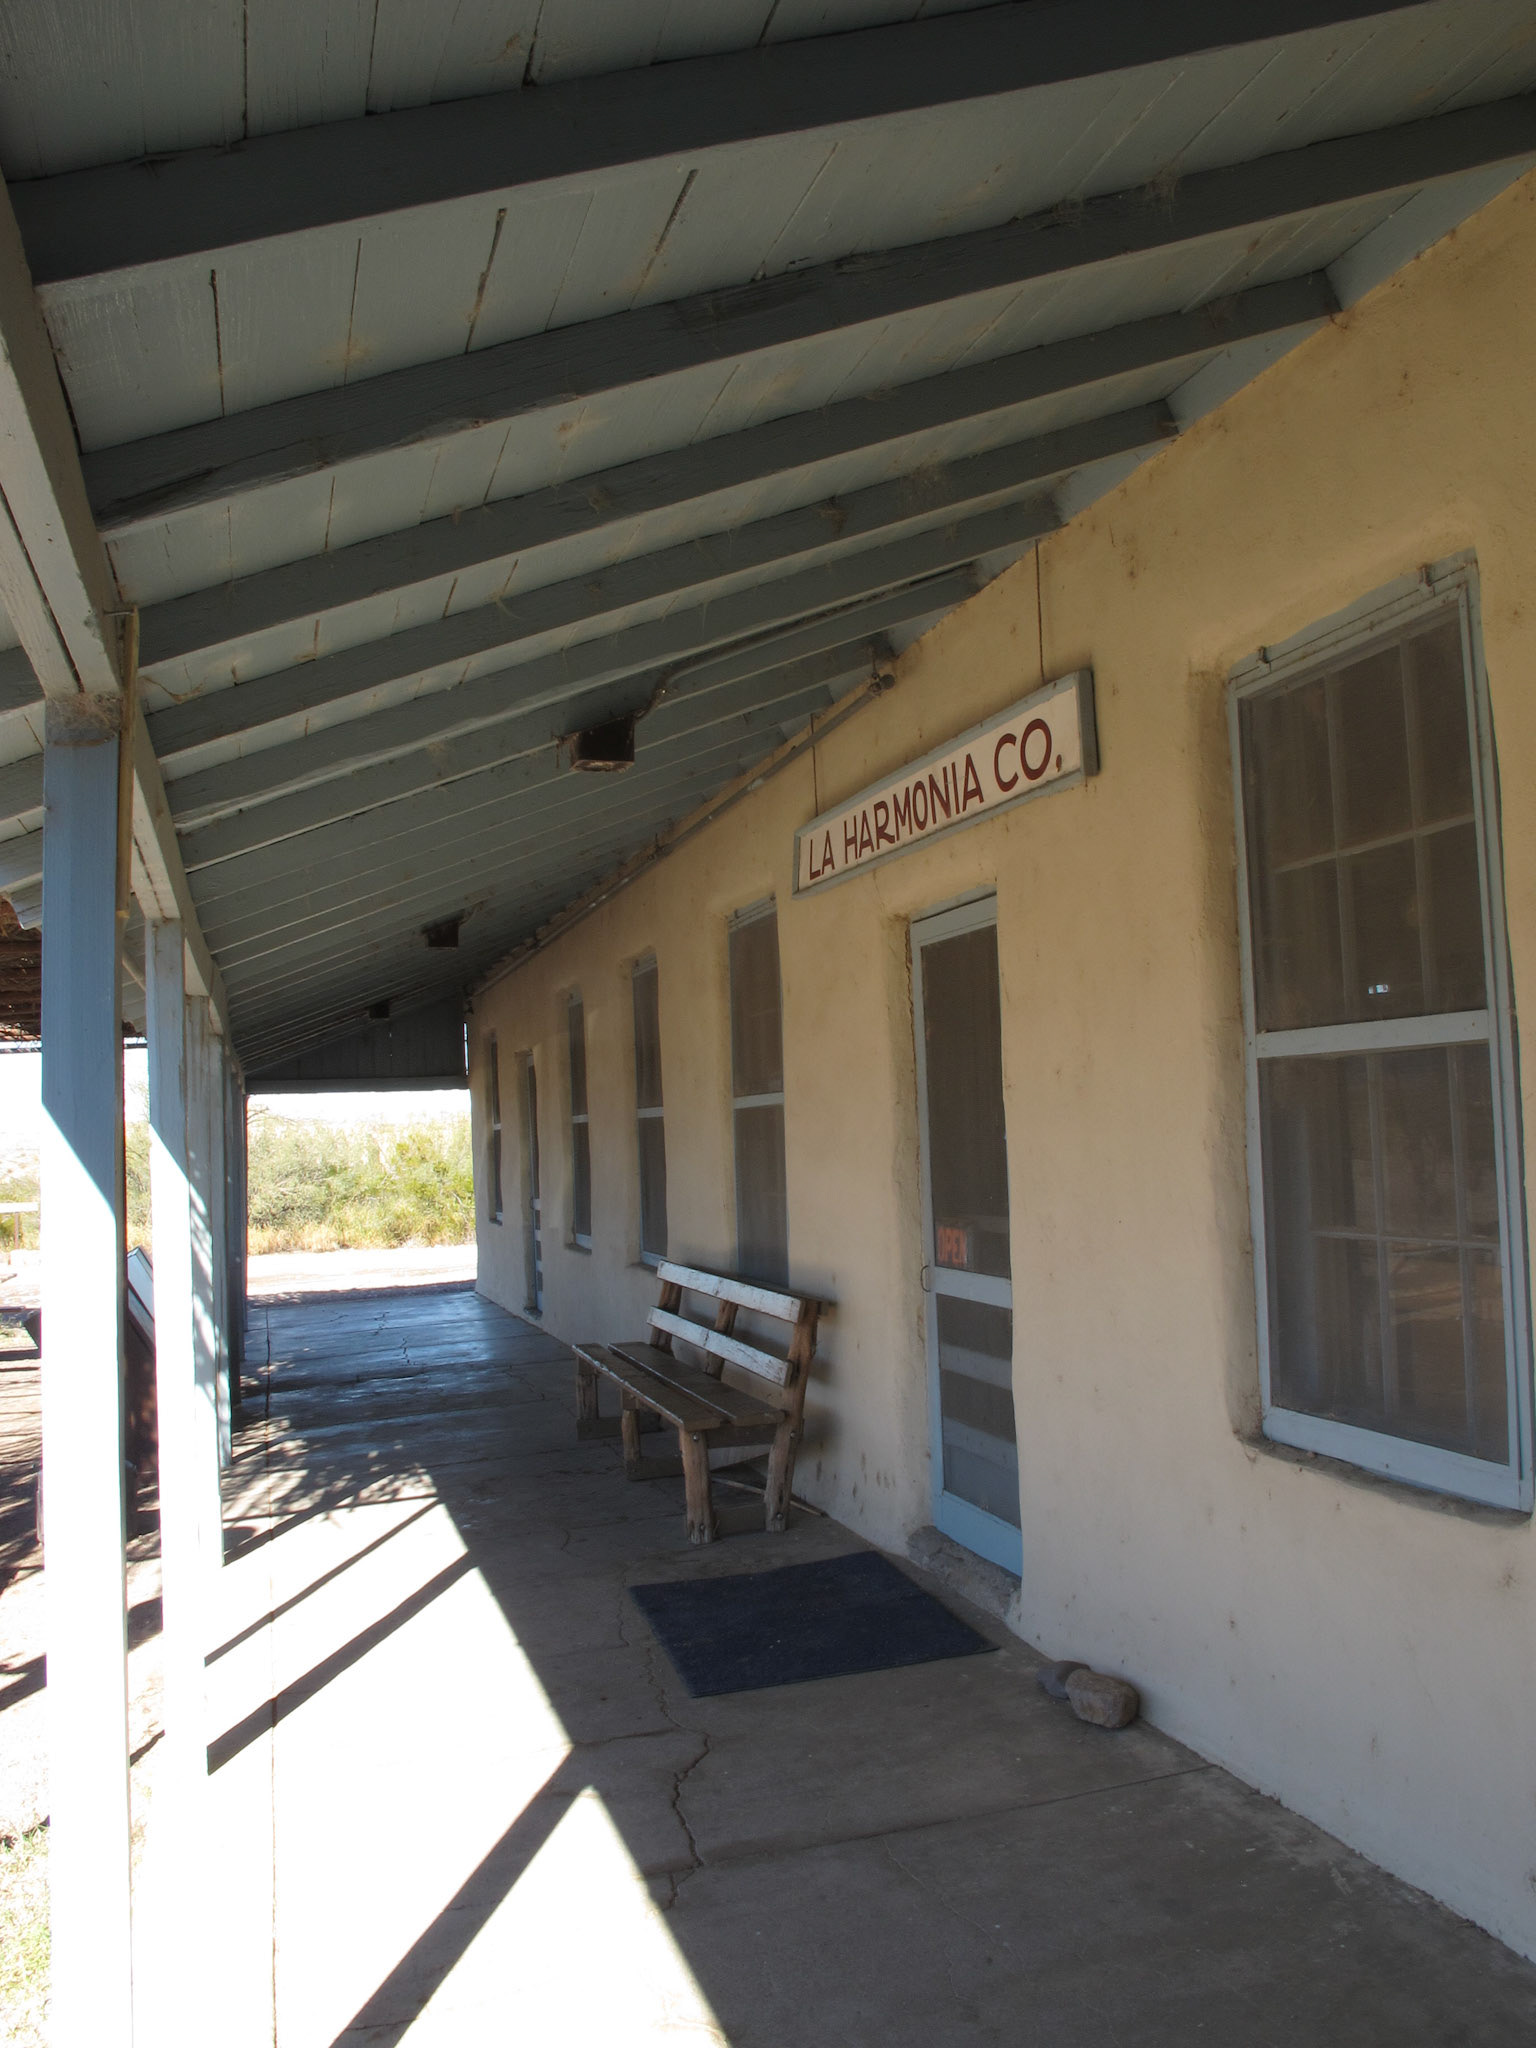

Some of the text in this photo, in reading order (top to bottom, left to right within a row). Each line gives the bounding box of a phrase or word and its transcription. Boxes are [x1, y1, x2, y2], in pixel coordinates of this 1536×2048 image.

[809, 718, 1062, 880] LA HARMONIA CO.
[938, 1225, 967, 1265] OPEN
